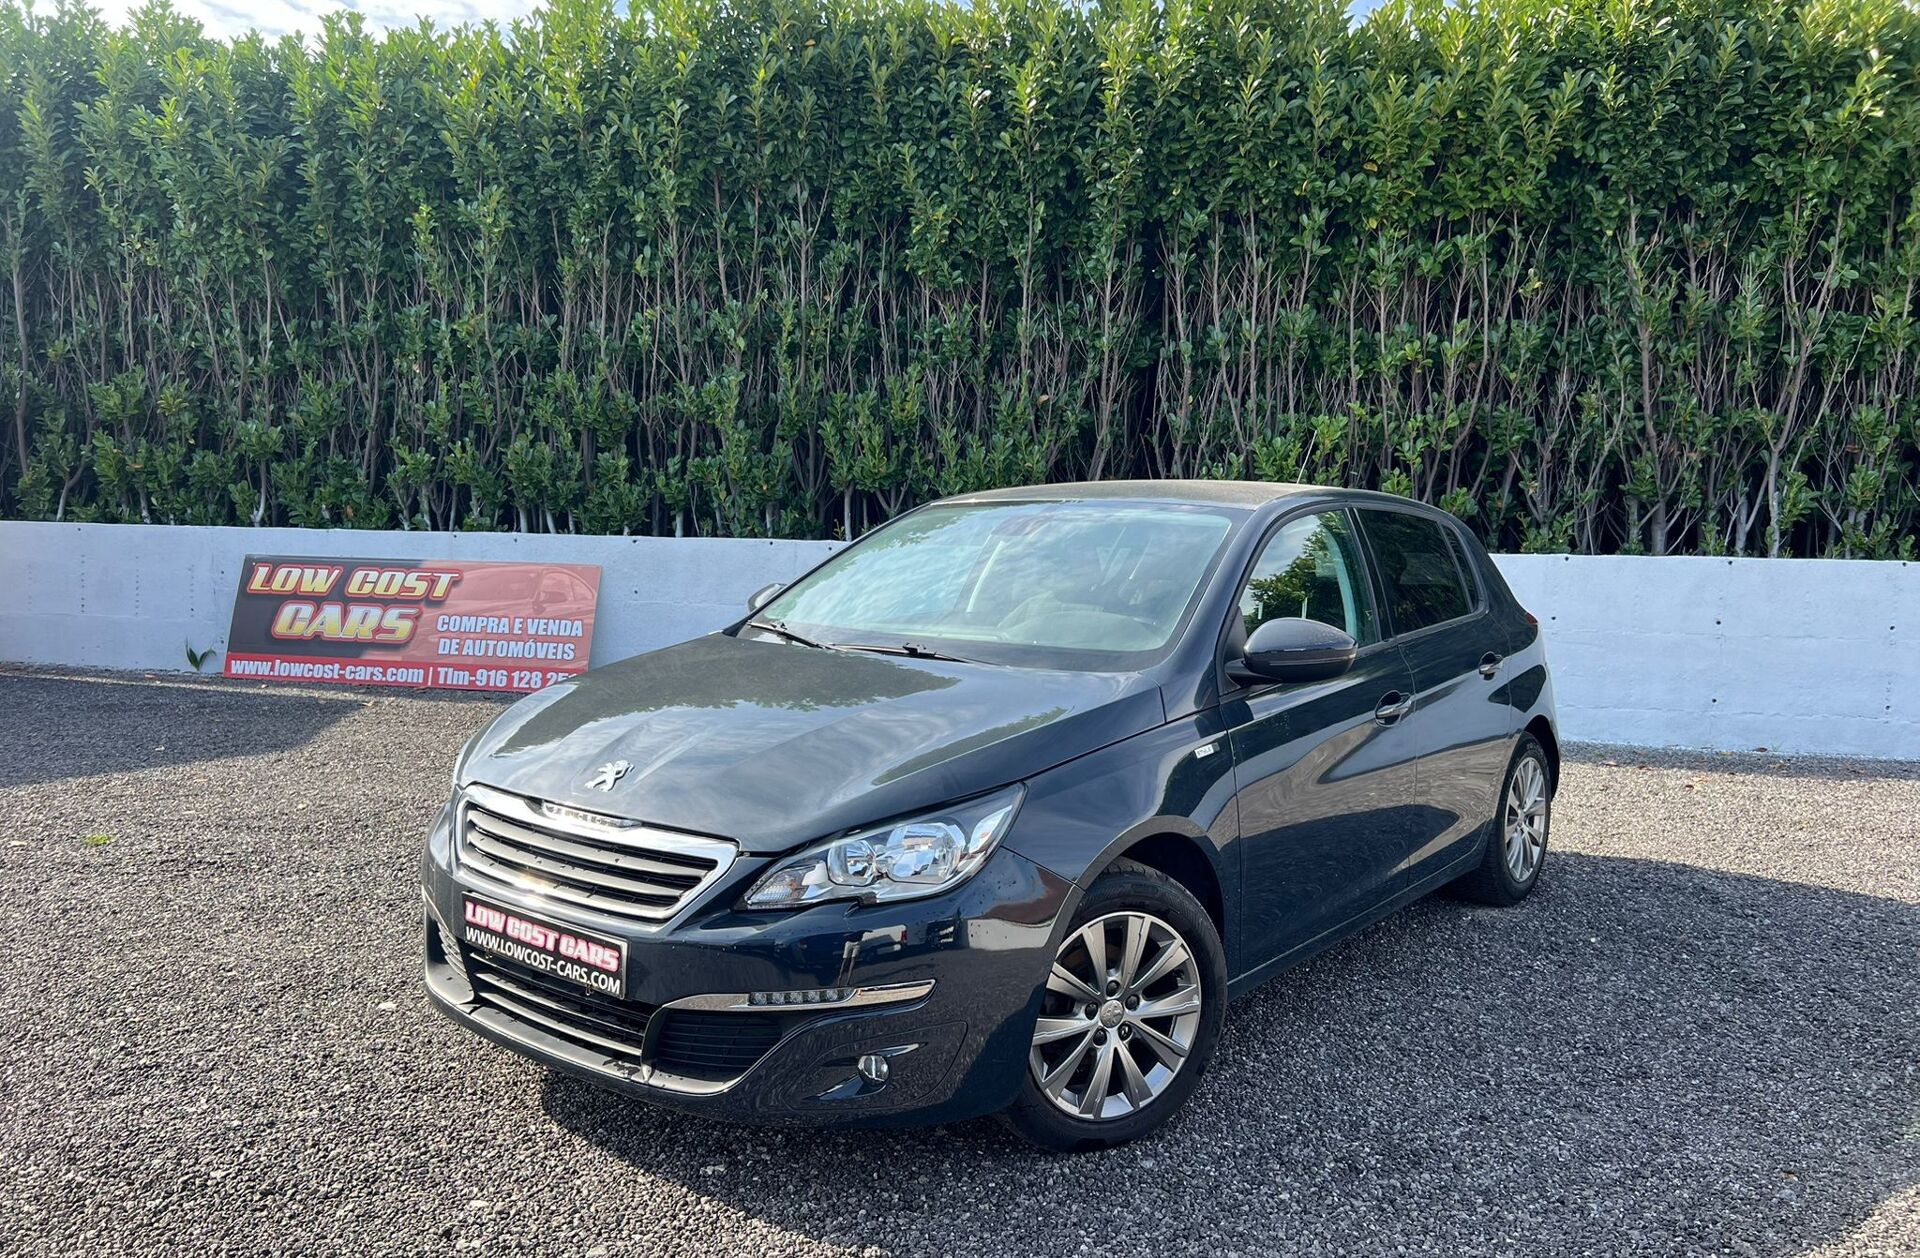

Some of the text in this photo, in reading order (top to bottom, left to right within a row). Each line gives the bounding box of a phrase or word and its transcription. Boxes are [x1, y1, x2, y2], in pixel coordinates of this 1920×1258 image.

[249, 565, 462, 599] LOW COST
[273, 602, 422, 642] CARS
[437, 615, 583, 637] COMPRA E VENDA
[438, 638, 575, 660] DE AUTOMÓVEIS
[231, 659, 424, 683] www.lowcost-cars.com
[511, 671, 542, 689] 128
[465, 901, 620, 972] LOW COST CARS
[466, 926, 620, 994] WWW.LOWCOST-CARS.COM
